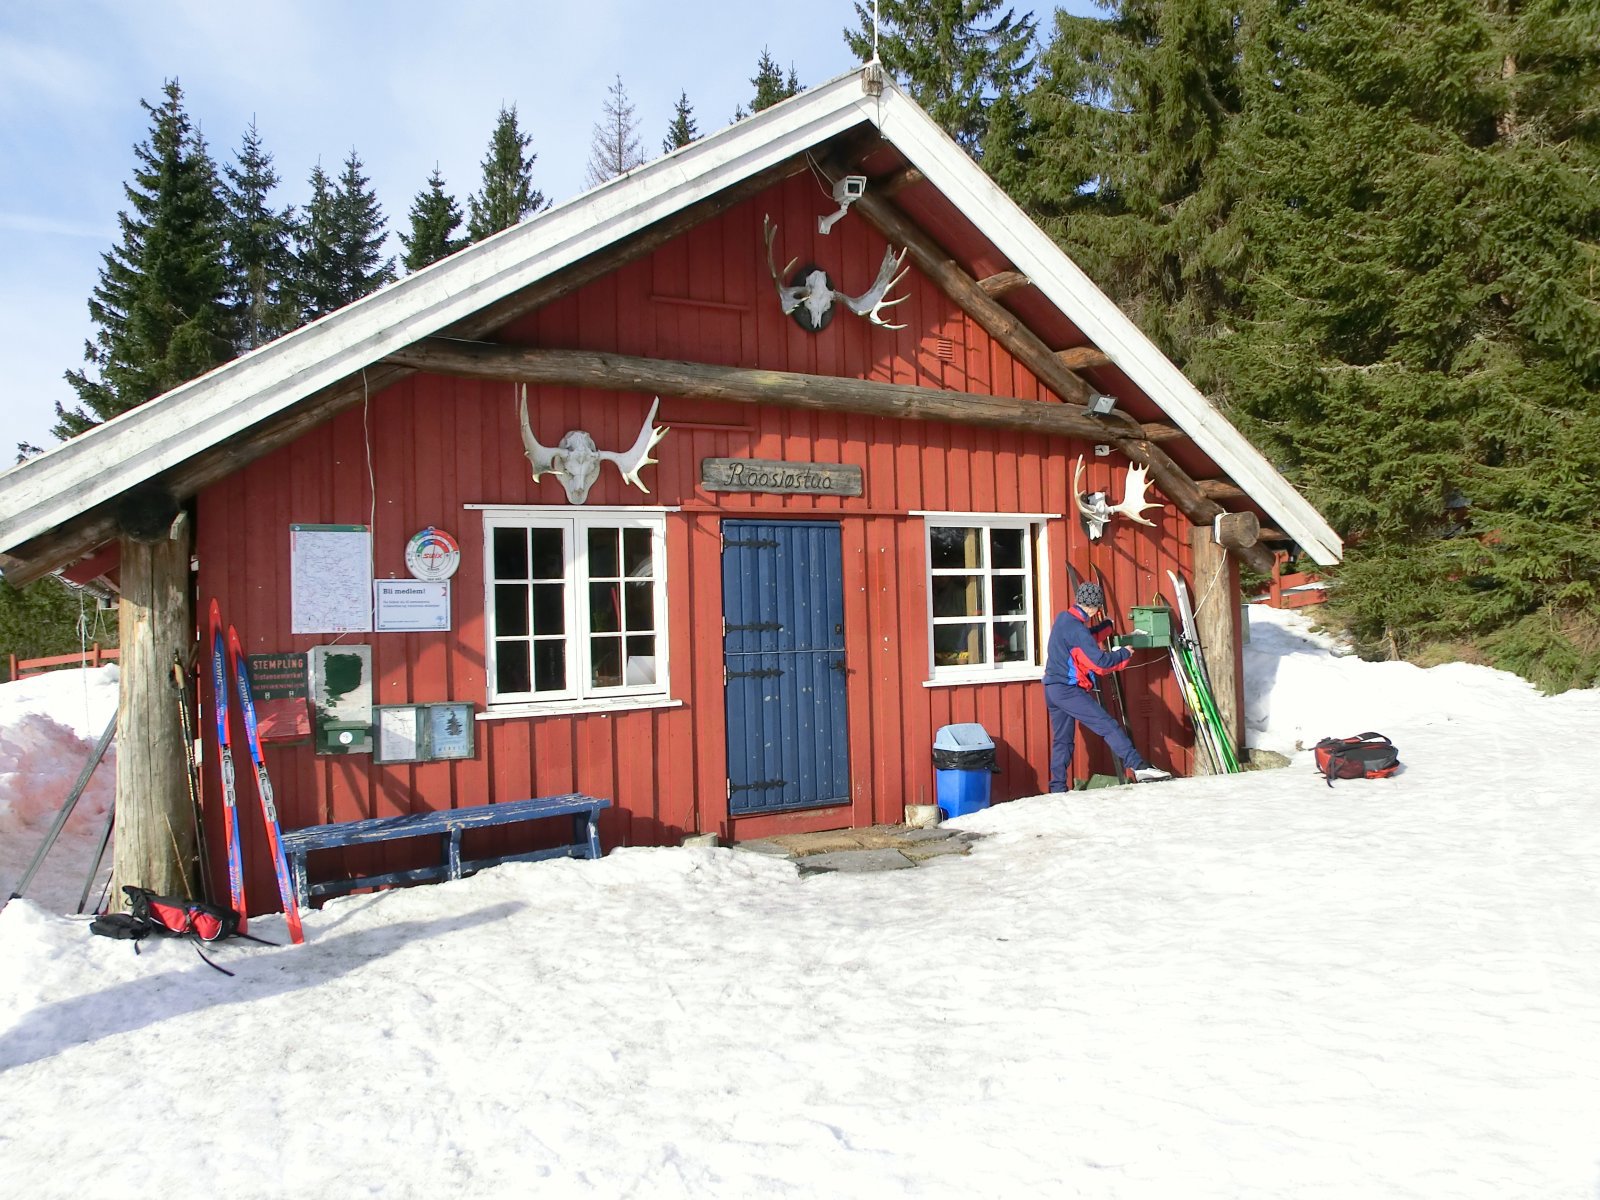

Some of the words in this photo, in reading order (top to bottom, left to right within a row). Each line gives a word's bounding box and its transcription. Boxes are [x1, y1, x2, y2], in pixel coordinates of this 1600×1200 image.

[215, 652, 223, 685] ATOMIC
[252, 659, 304, 670] STEMPLING
[238, 675, 250, 709] ATOMIC
